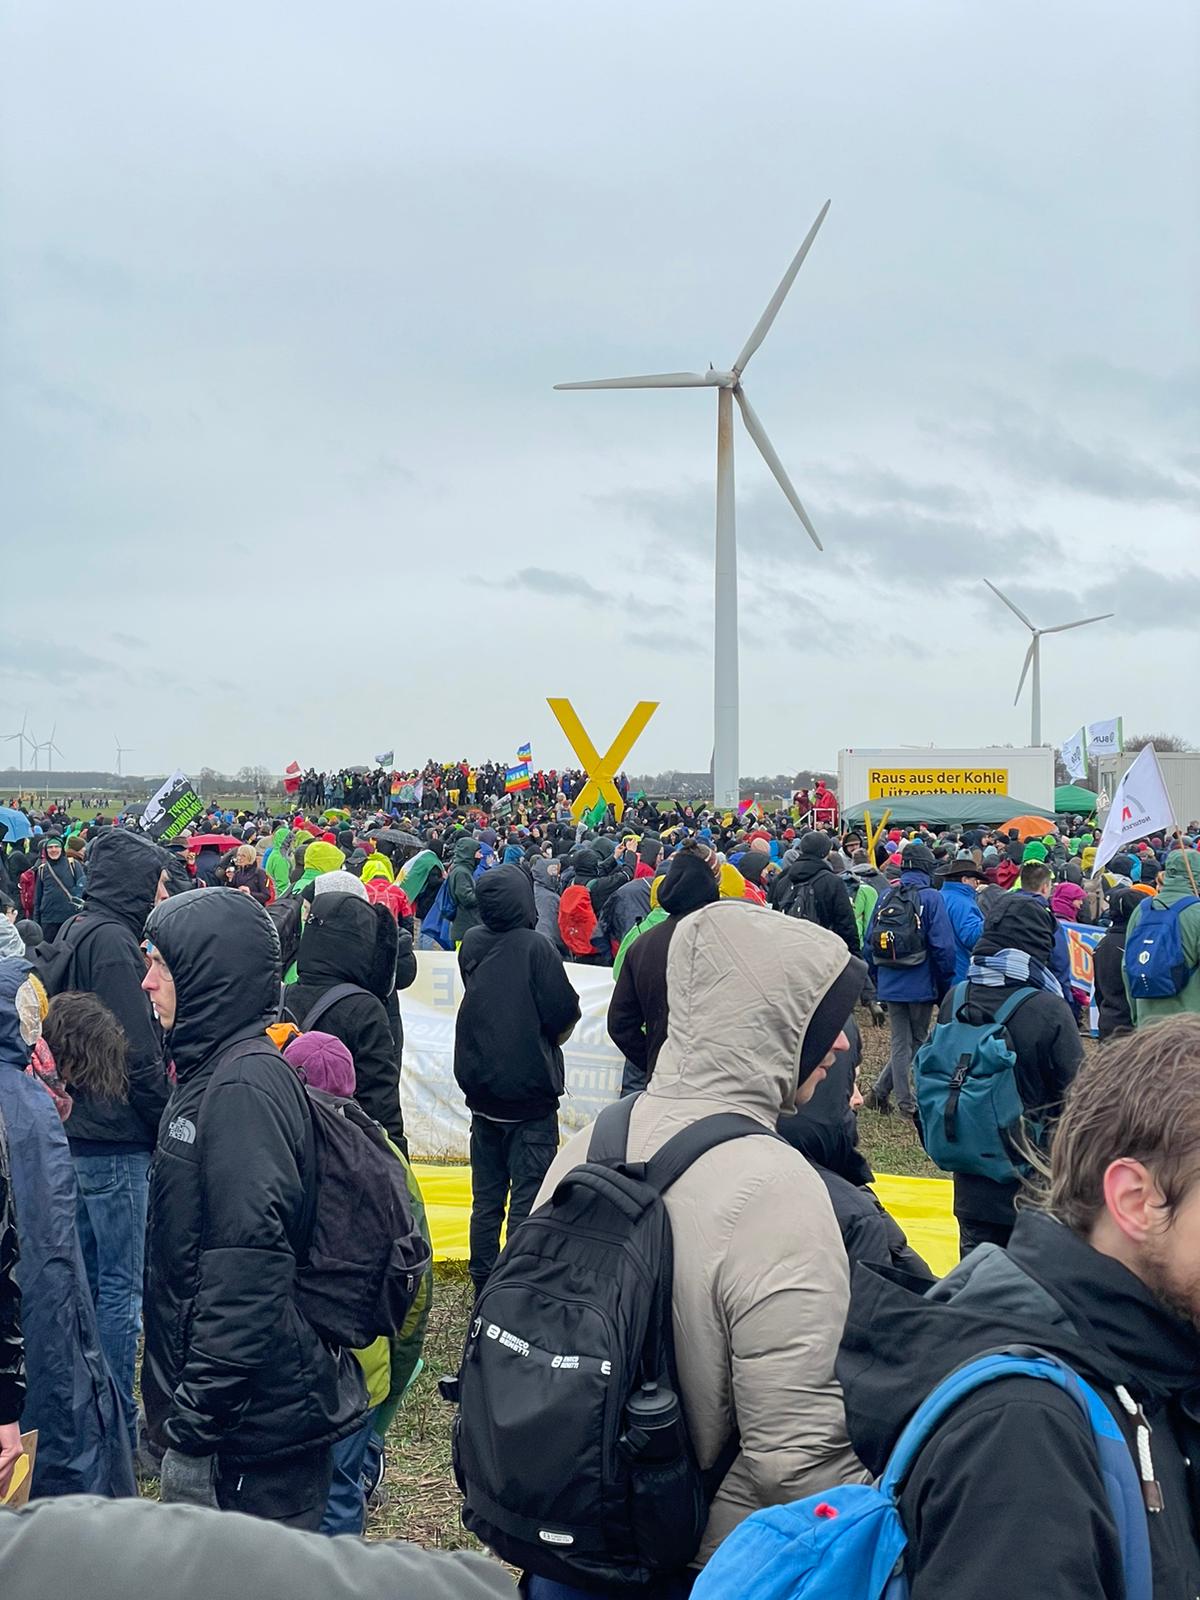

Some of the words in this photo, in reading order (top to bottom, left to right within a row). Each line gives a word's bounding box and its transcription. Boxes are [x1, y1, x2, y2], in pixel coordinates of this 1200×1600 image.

[872, 772, 906, 784] Raus
[909, 775, 933, 784] aus
[937, 772, 961, 784] der
[964, 772, 1005, 784] Kohle
